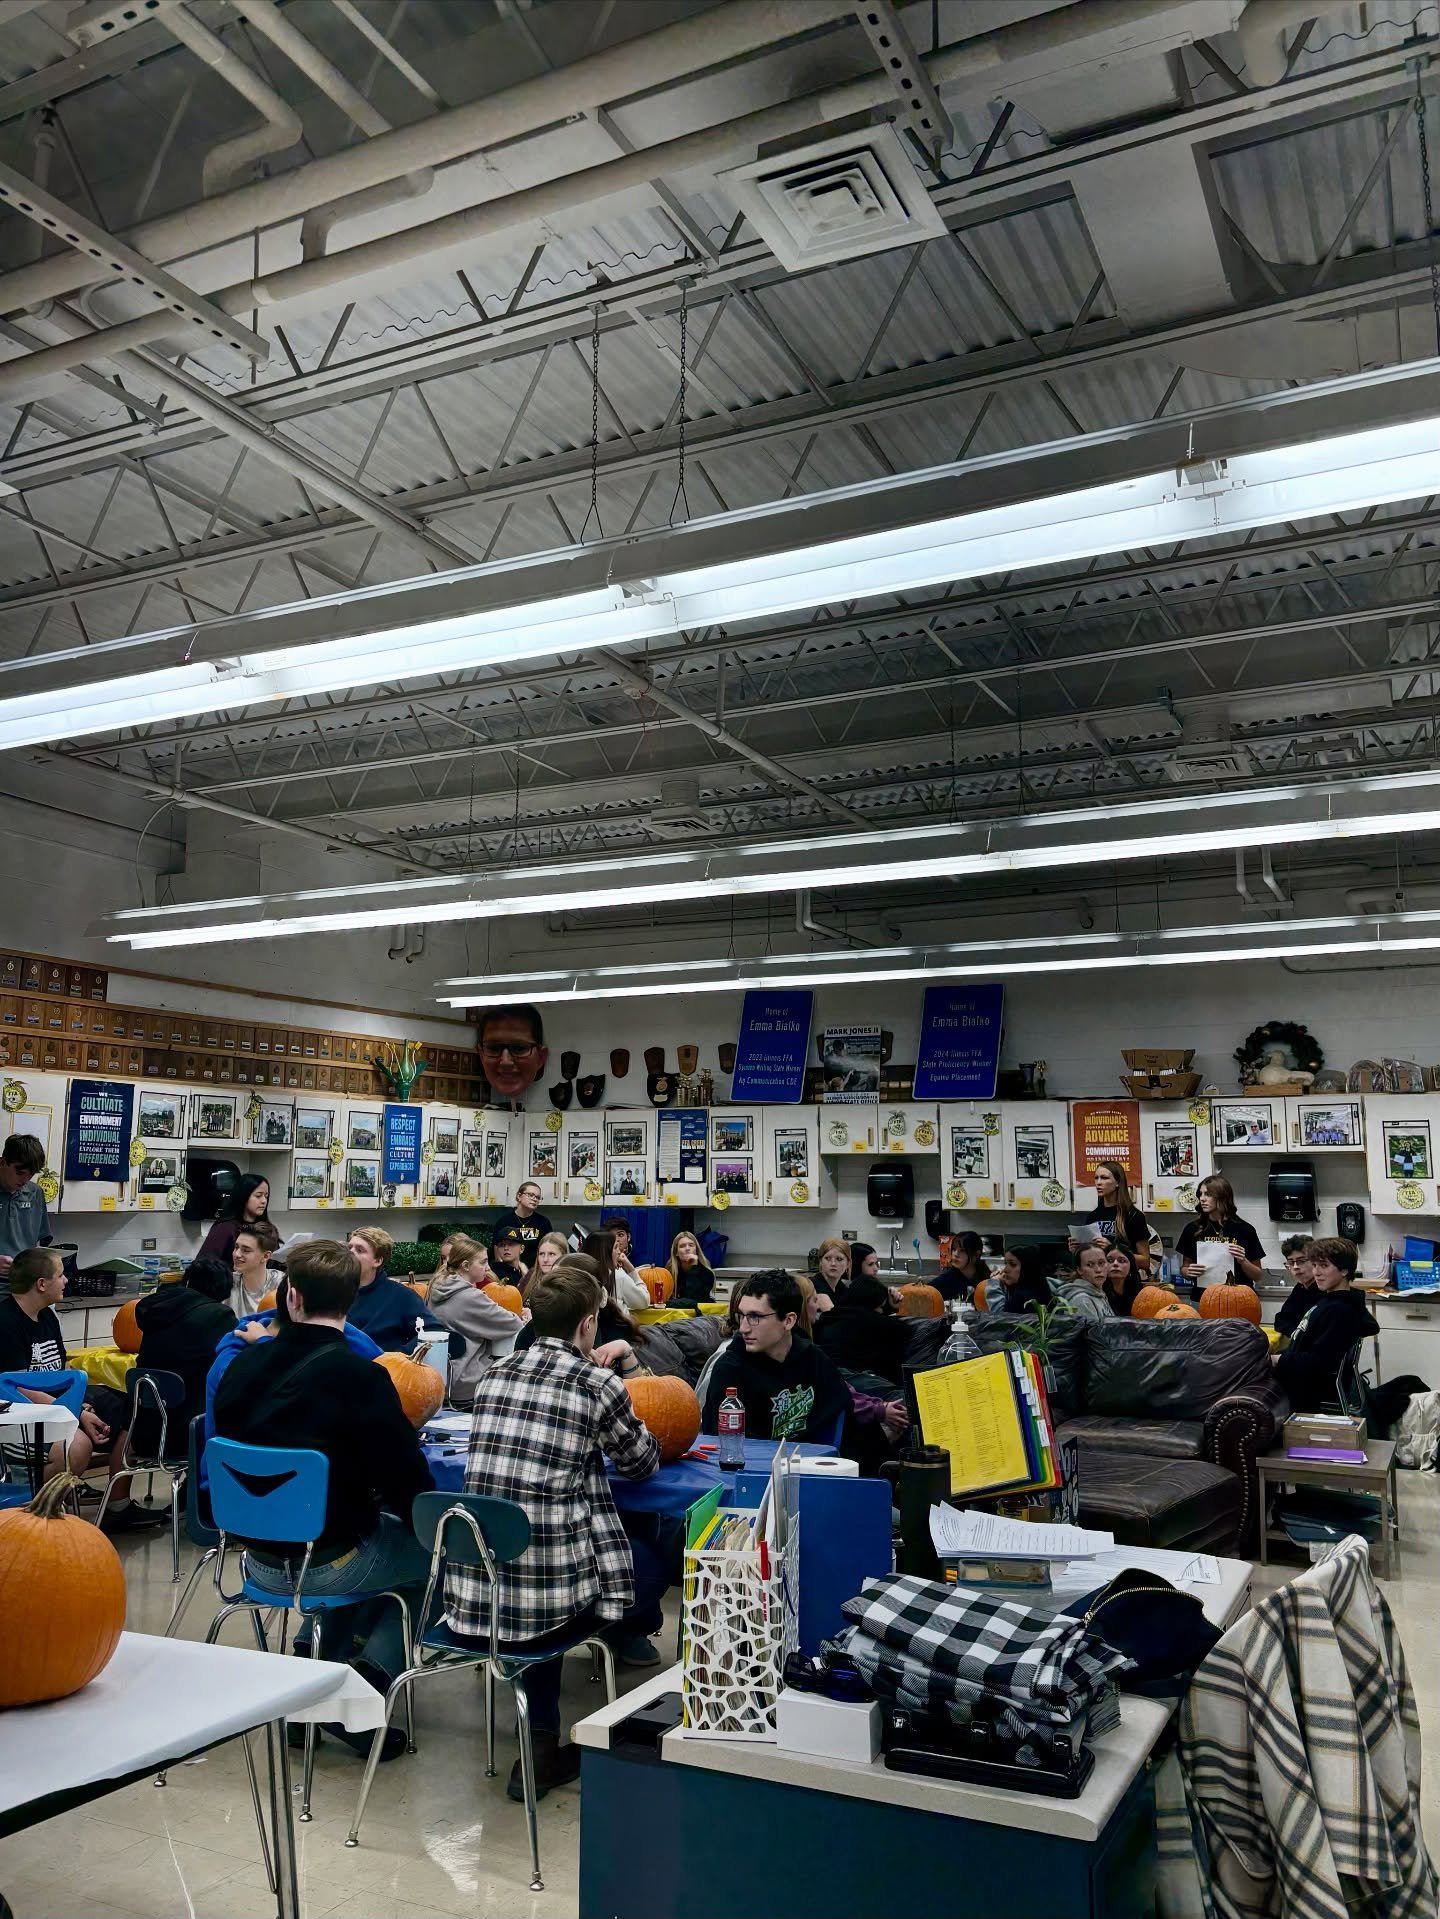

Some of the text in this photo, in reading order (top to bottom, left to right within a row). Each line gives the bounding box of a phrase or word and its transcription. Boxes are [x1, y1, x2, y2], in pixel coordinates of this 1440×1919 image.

[749, 1020, 773, 1031] Emma
[933, 1016, 957, 1027] Emma
[849, 1027, 872, 1035] JONES
[934, 1050, 948, 1058] 2024
[951, 1073, 981, 1081] Placement
[81, 1096, 123, 1112] CULTIVATE
[80, 1114, 122, 1127] ENVIRONMENT
[391, 1118, 416, 1131] RESPECT
[1084, 1115, 1128, 1125] INDIVIDUAL'S
[80, 1129, 120, 1143] INDIVIDUAL
[390, 1134, 415, 1146] EMBRACE
[1085, 1129, 1129, 1142] ADVANCE
[1086, 1147, 1129, 1155] COMMUNITIES
[78, 1152, 119, 1165] DIFFERENCES
